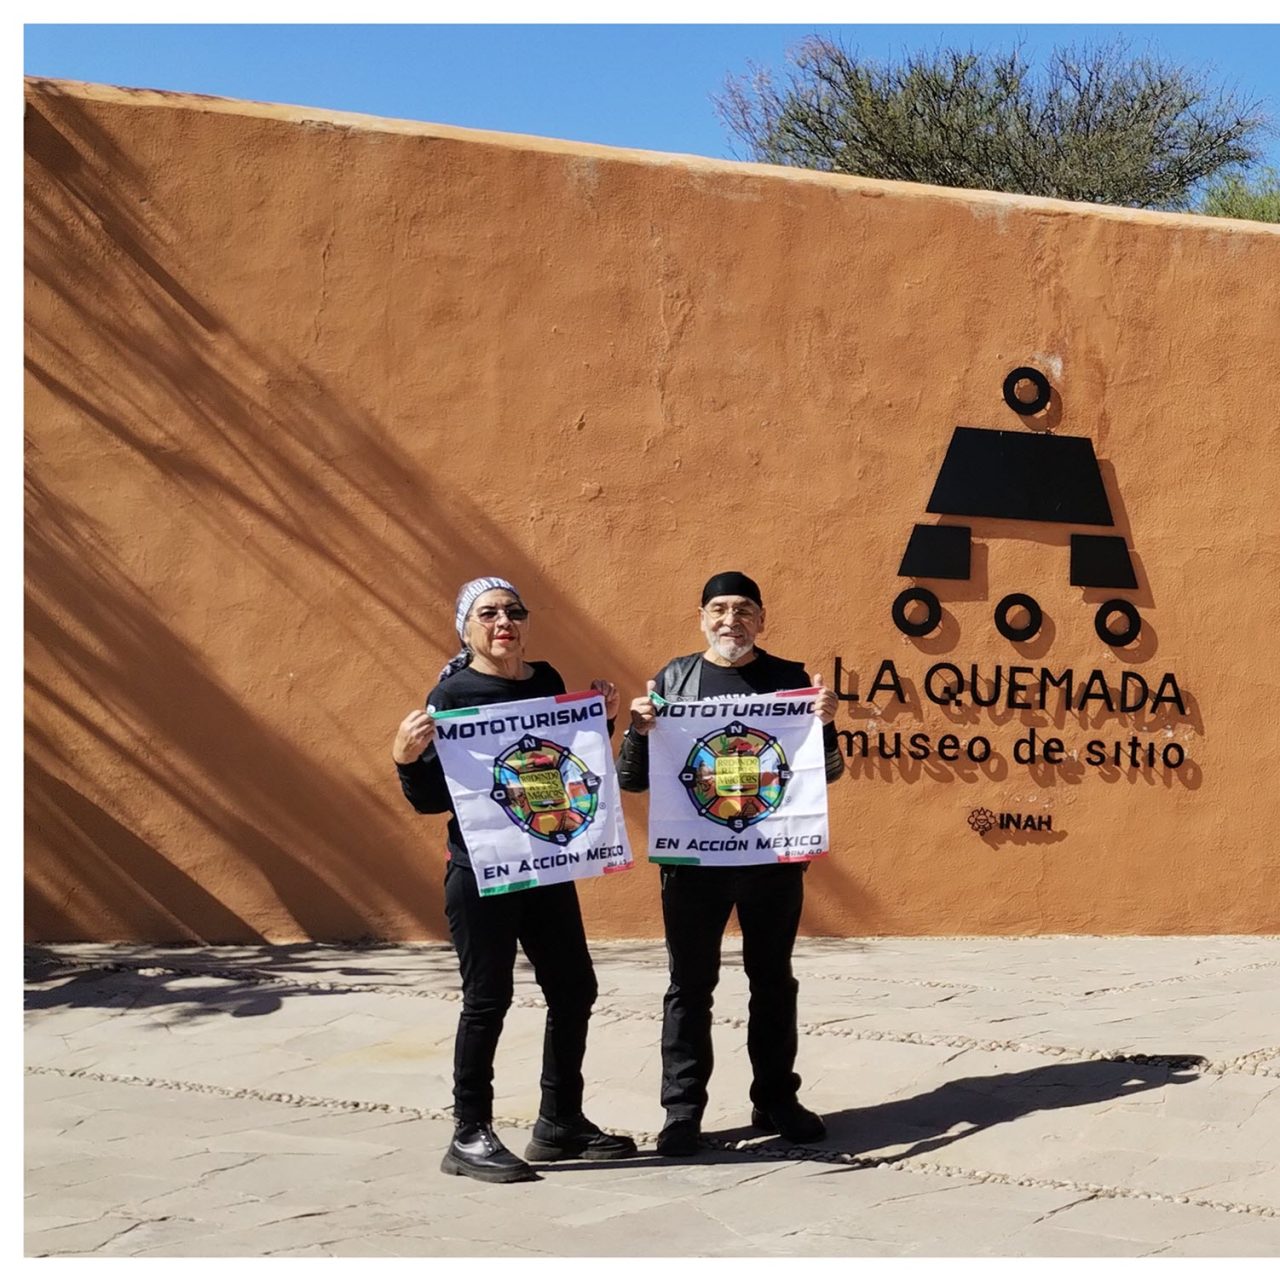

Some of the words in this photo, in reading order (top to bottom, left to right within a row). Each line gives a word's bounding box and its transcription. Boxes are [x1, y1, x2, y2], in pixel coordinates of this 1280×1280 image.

[834, 657, 906, 704] LA
[924, 661, 1186, 715] QUEMADA
[436, 702, 604, 740] MOTOTURISMO
[730, 724, 742, 733] N
[523, 738, 536, 748] N
[837, 729, 991, 763] museo
[1013, 728, 1064, 765] de
[1086, 735, 1185, 769] sitio
[682, 772, 694, 781] O
[781, 770, 791, 779] E
[586, 777, 598, 786] E
[493, 790, 506, 799] O
[734, 819, 744, 829] S
[999, 813, 1052, 831] INAH
[556, 833, 567, 842] S
[655, 838, 680, 850] EN
[686, 835, 749, 852] ACCIÓN
[756, 832, 822, 850] MÉXICO
[483, 864, 510, 880] EN
[518, 850, 580, 872] ACCIÓN
[586, 843, 624, 862] MÉXICO
